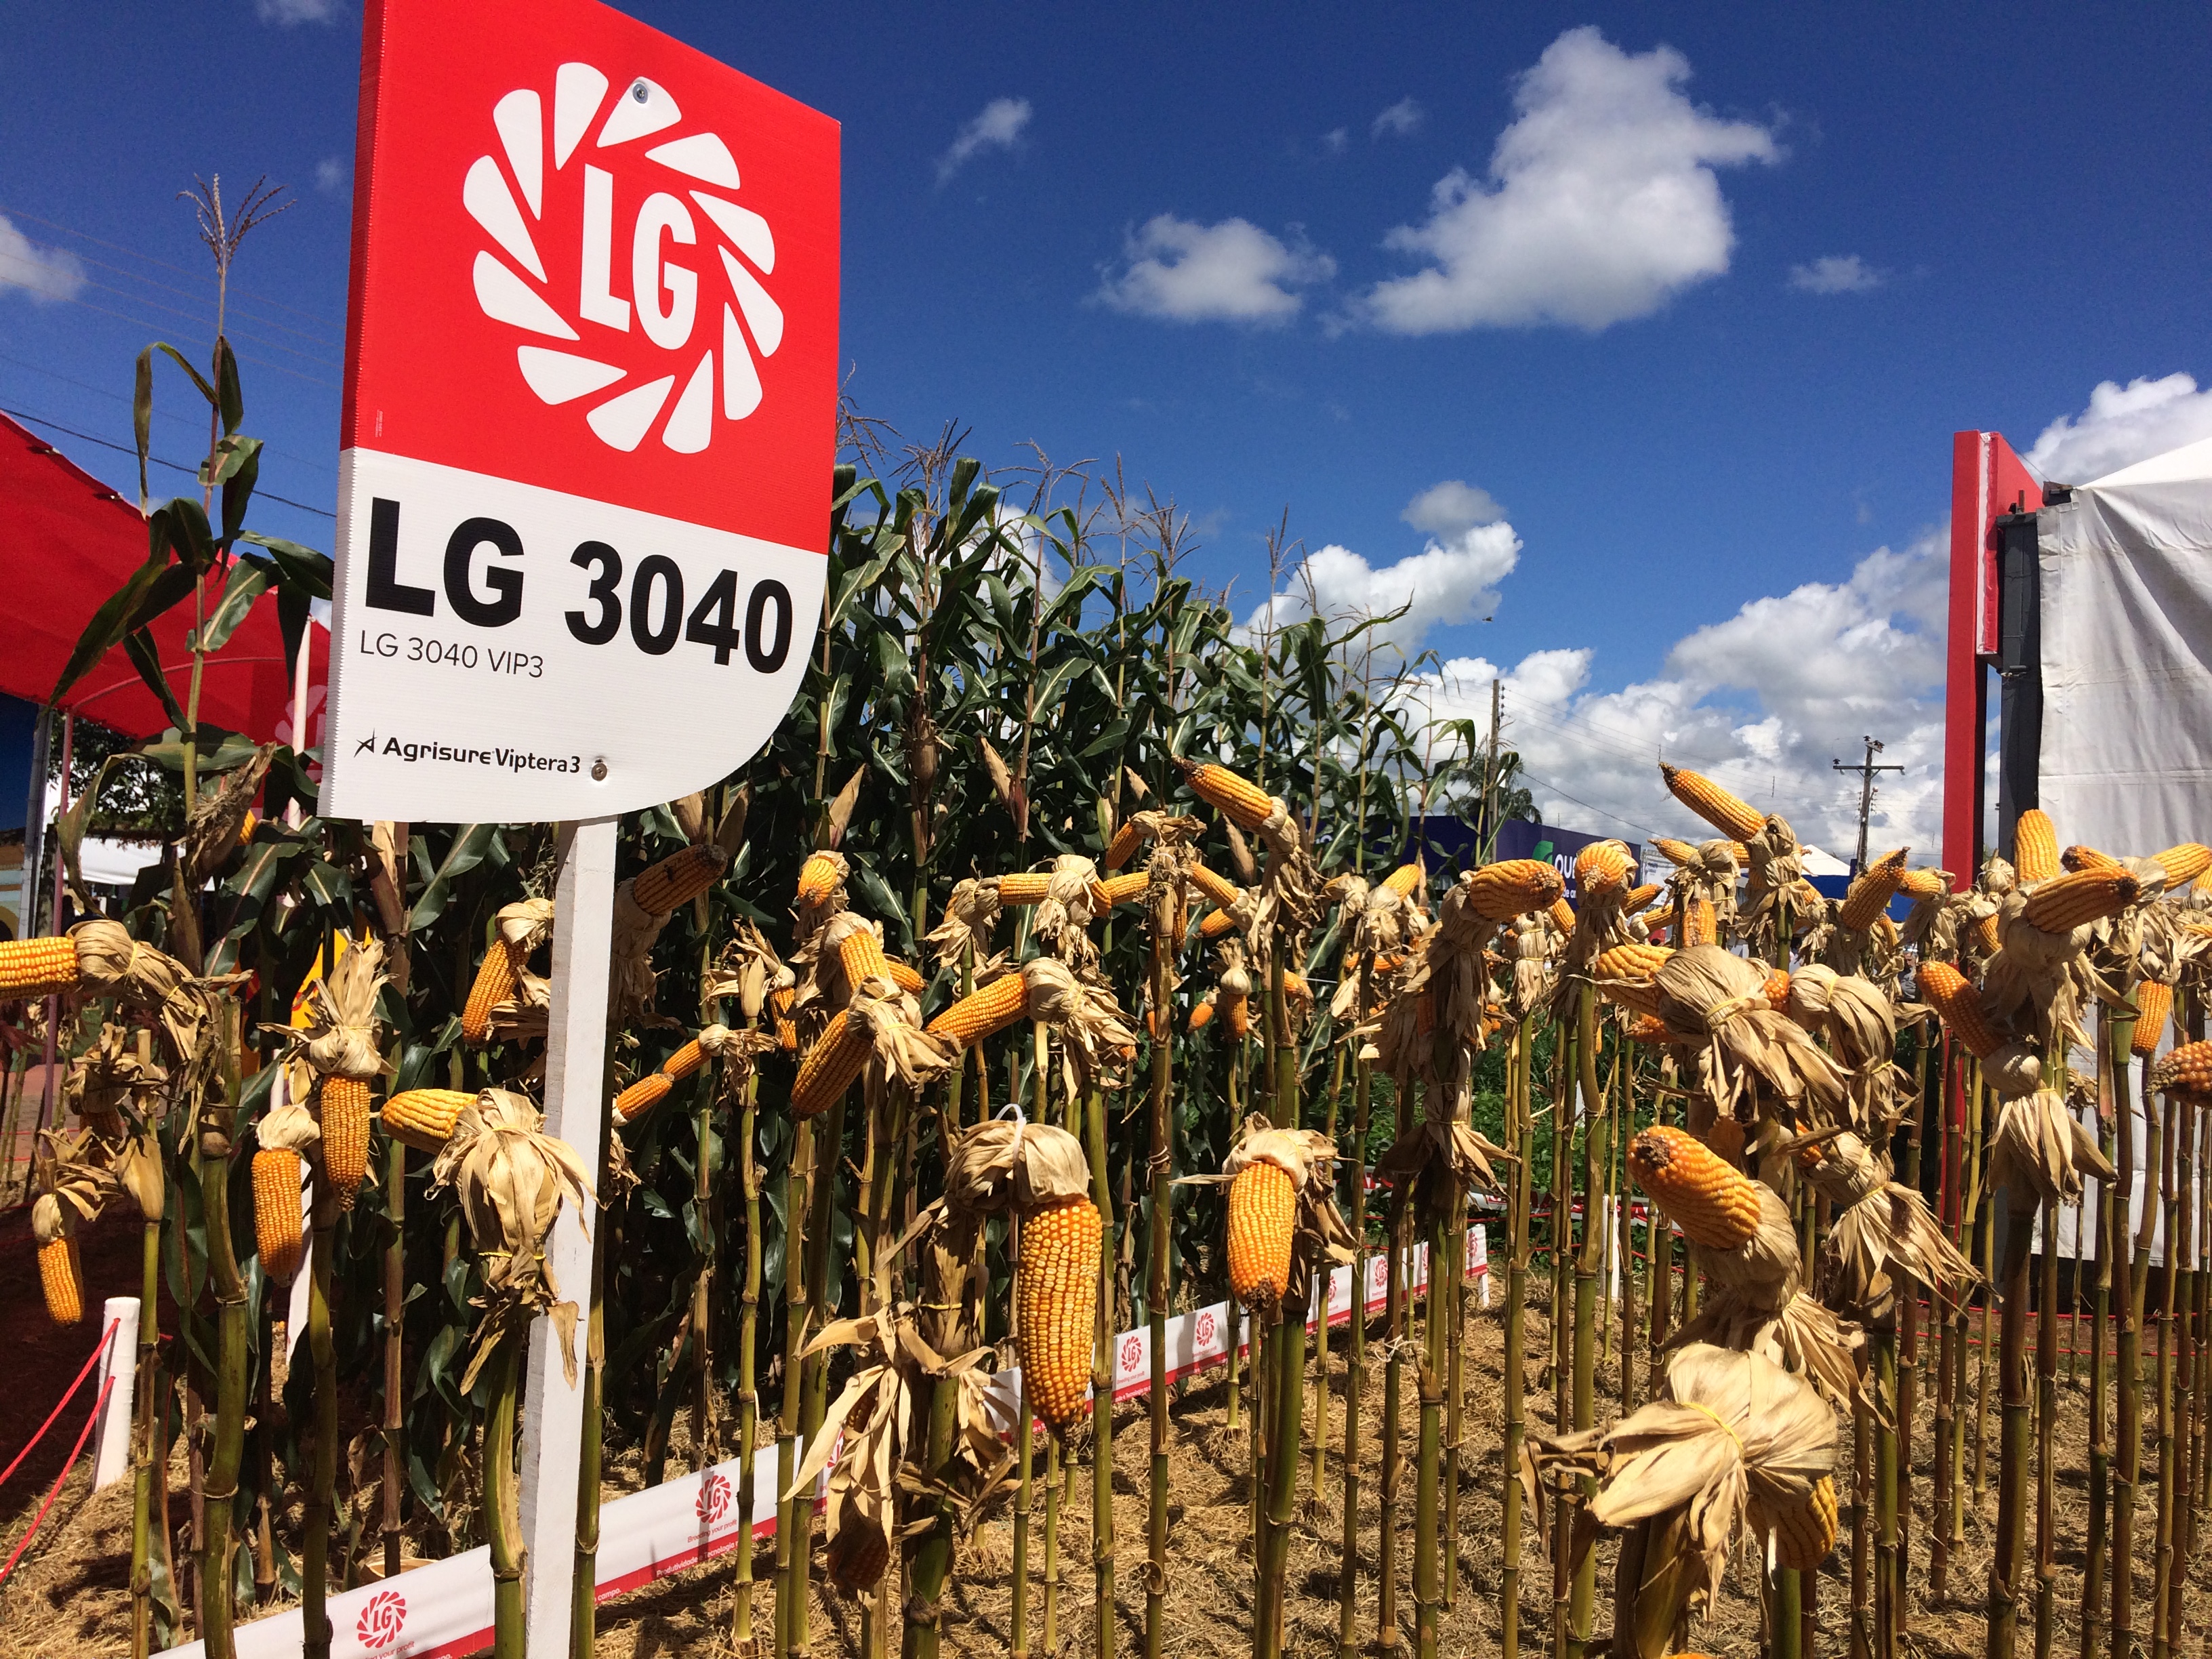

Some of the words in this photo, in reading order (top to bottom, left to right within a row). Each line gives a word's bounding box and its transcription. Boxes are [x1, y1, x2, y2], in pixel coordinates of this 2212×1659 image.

[580, 163, 697, 350] LG
[365, 497, 525, 628] LG
[565, 540, 793, 674] 3040
[361, 630, 398, 657] LG
[407, 637, 478, 669] 3040
[487, 649, 544, 678] VIP3
[382, 737, 491, 765] Agrisure
[1202, 1322, 1209, 1337] LG
[1128, 1347, 1136, 1361] LG
[707, 1488, 721, 1511] LG
[688, 1530, 710, 1543] Breeding
[712, 1525, 724, 1534] your
[724, 1519, 737, 1530] profit
[656, 1556, 698, 1578] Produtividade
[703, 1542, 735, 1558] Tecnologia
[597, 1587, 622, 1602] campo.
[373, 1605, 392, 1633] LG
[396, 1641, 415, 1656] profit
